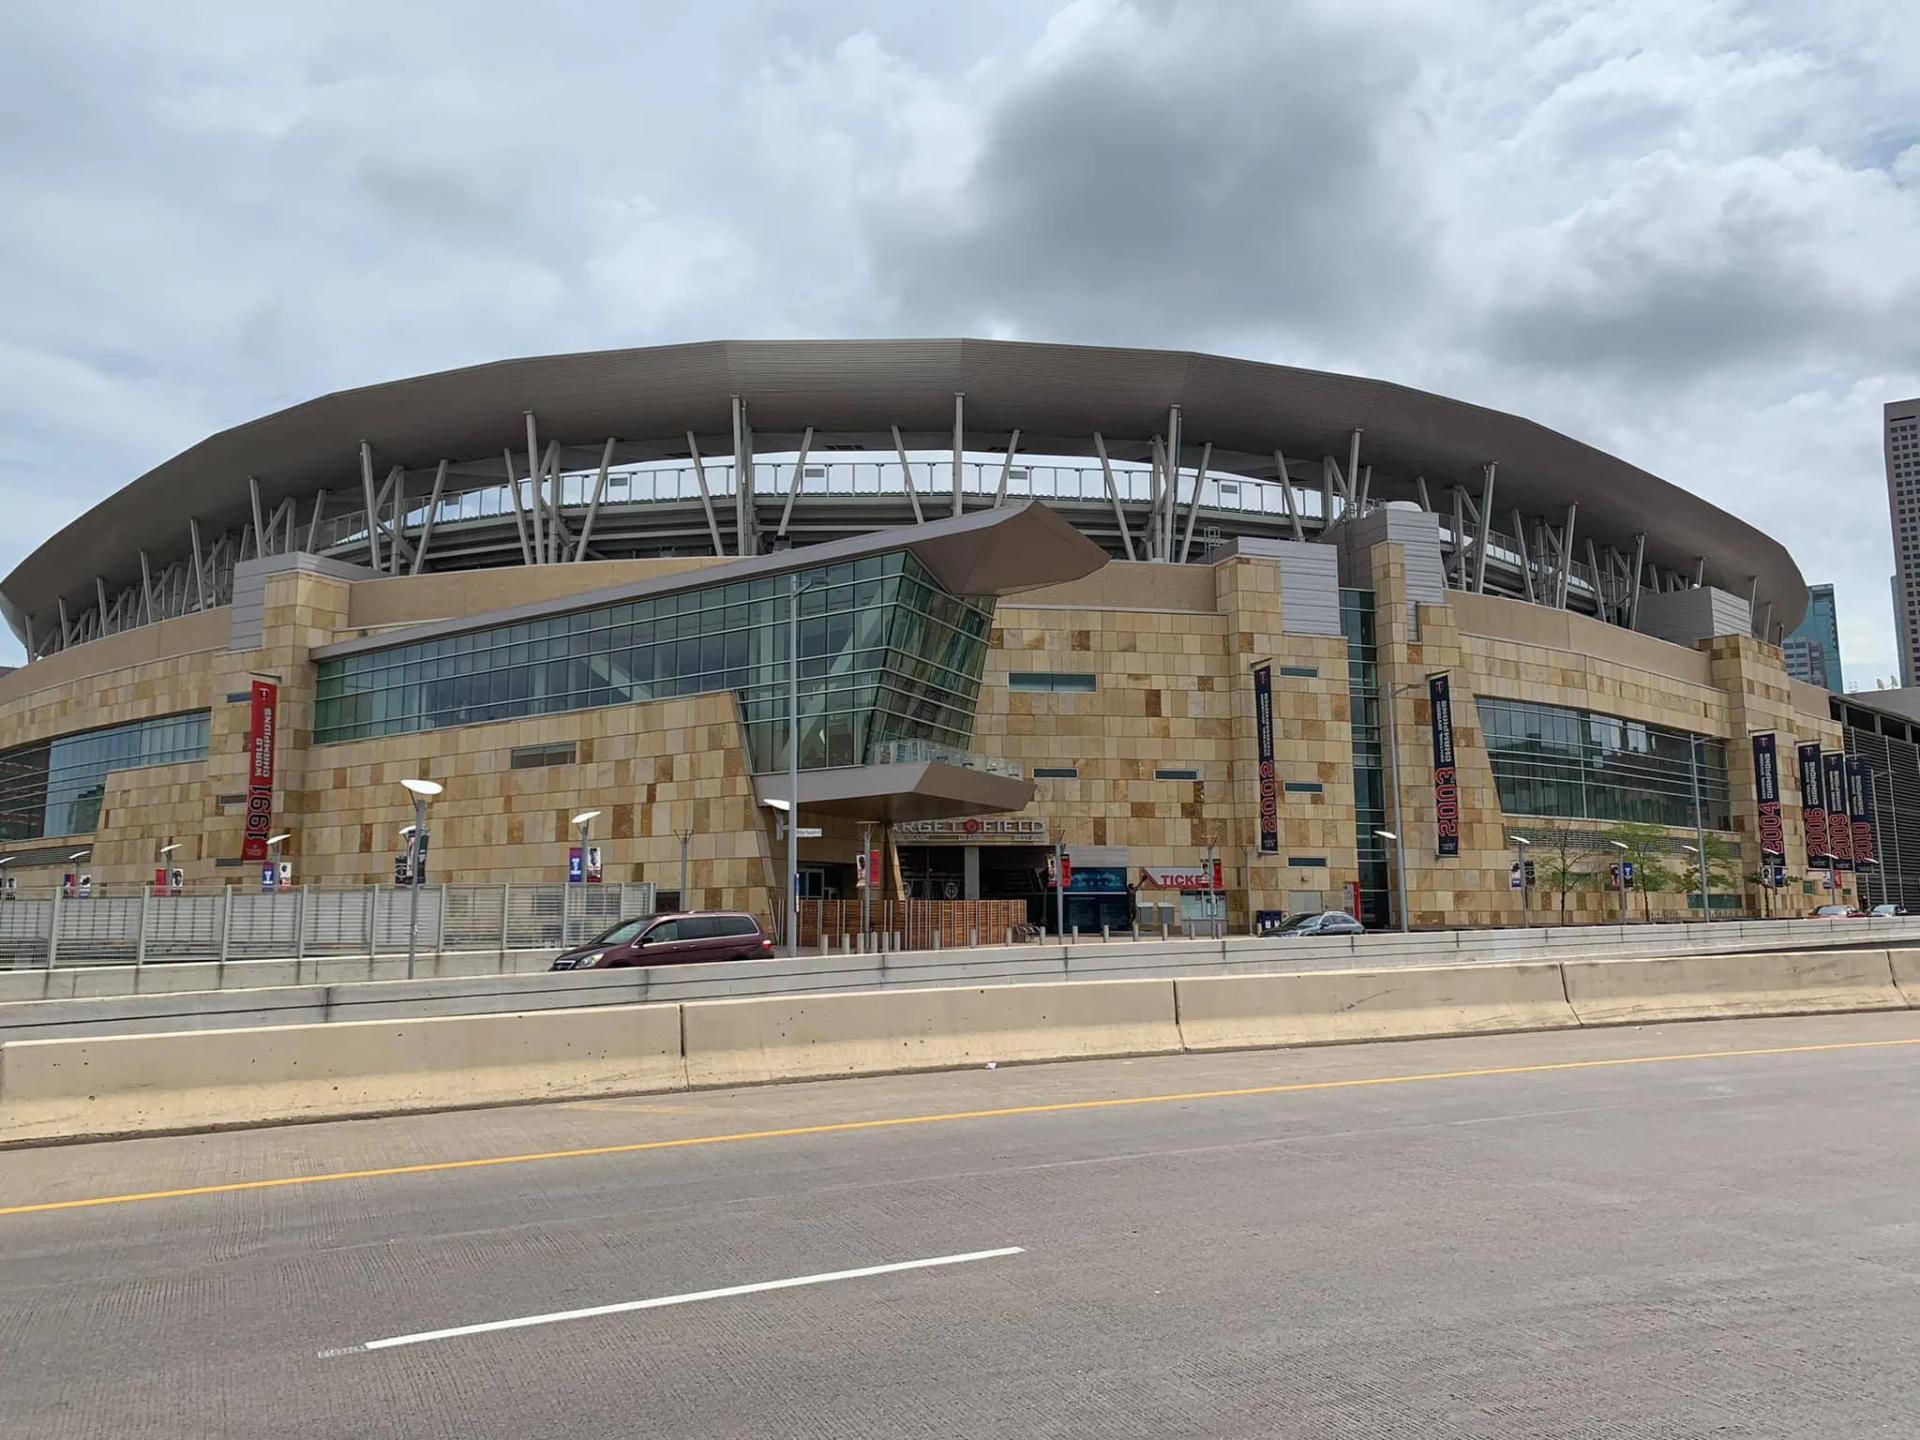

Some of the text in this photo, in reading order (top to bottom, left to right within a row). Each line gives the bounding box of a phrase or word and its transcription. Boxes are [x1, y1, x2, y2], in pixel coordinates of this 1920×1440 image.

[255, 737, 263, 776] WORLD
[263, 707, 272, 777] CHAMPIONS
[1441, 700, 1451, 762] CHAMPIONS
[247, 785, 272, 840] 1991
[1260, 761, 1277, 833] 2002
[1434, 767, 1458, 837] 2003
[892, 819, 1045, 833] ARGET FIELD
[1760, 801, 1784, 854] 2004
[1805, 808, 1828, 856] 2006
[1829, 814, 1852, 860] 2009
[1161, 874, 1203, 886] TICKE
